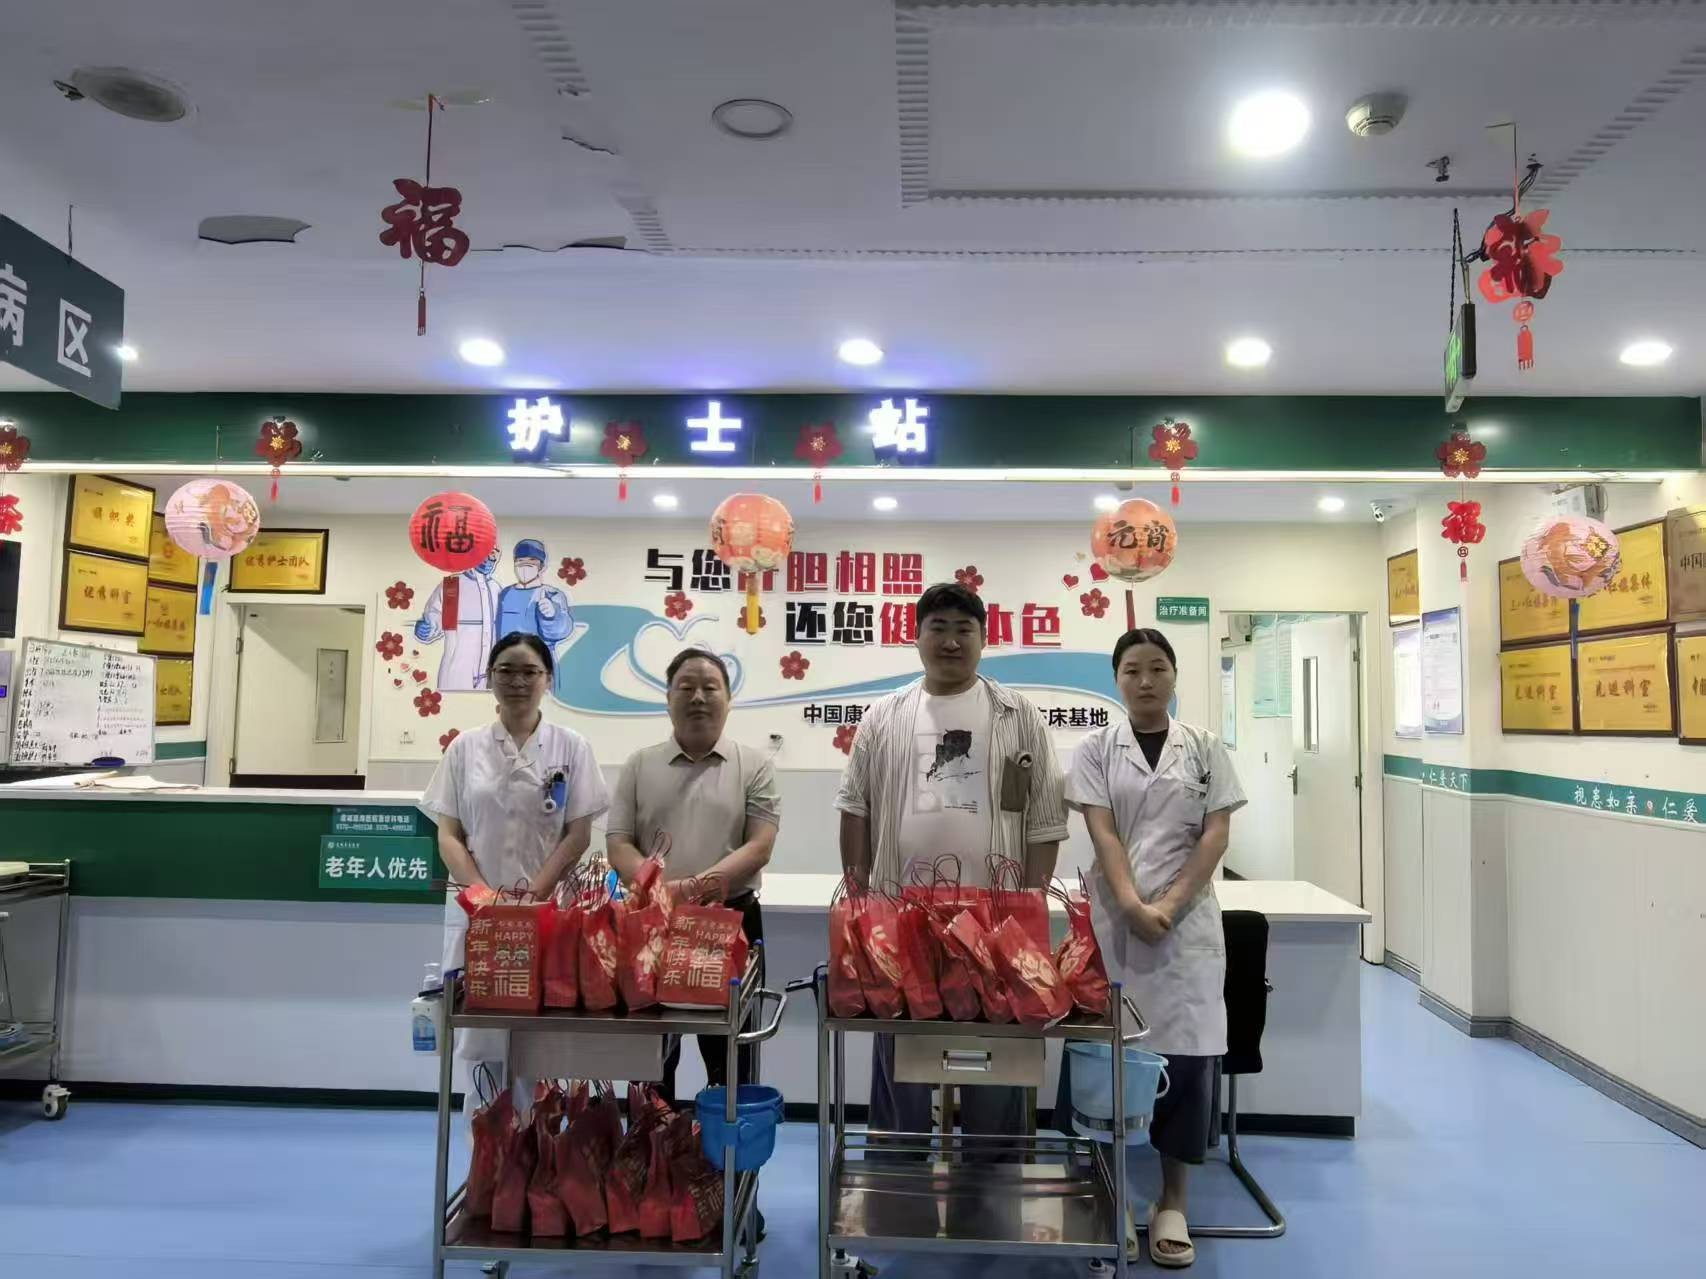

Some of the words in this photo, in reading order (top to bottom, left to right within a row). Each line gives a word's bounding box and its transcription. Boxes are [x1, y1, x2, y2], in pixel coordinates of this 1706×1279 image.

[508, 397, 929, 452] 护士站
[421, 501, 475, 554] 福
[1107, 519, 1169, 553] 元宵
[785, 601, 1061, 648] 还您健本色
[325, 856, 428, 880] 老年人优先
[495, 931, 534, 942] HAPPY
[663, 916, 696, 985] 新年快乐
[468, 918, 493, 998] 新年快乐
[688, 960, 723, 988] 福
[494, 969, 530, 997] 福
